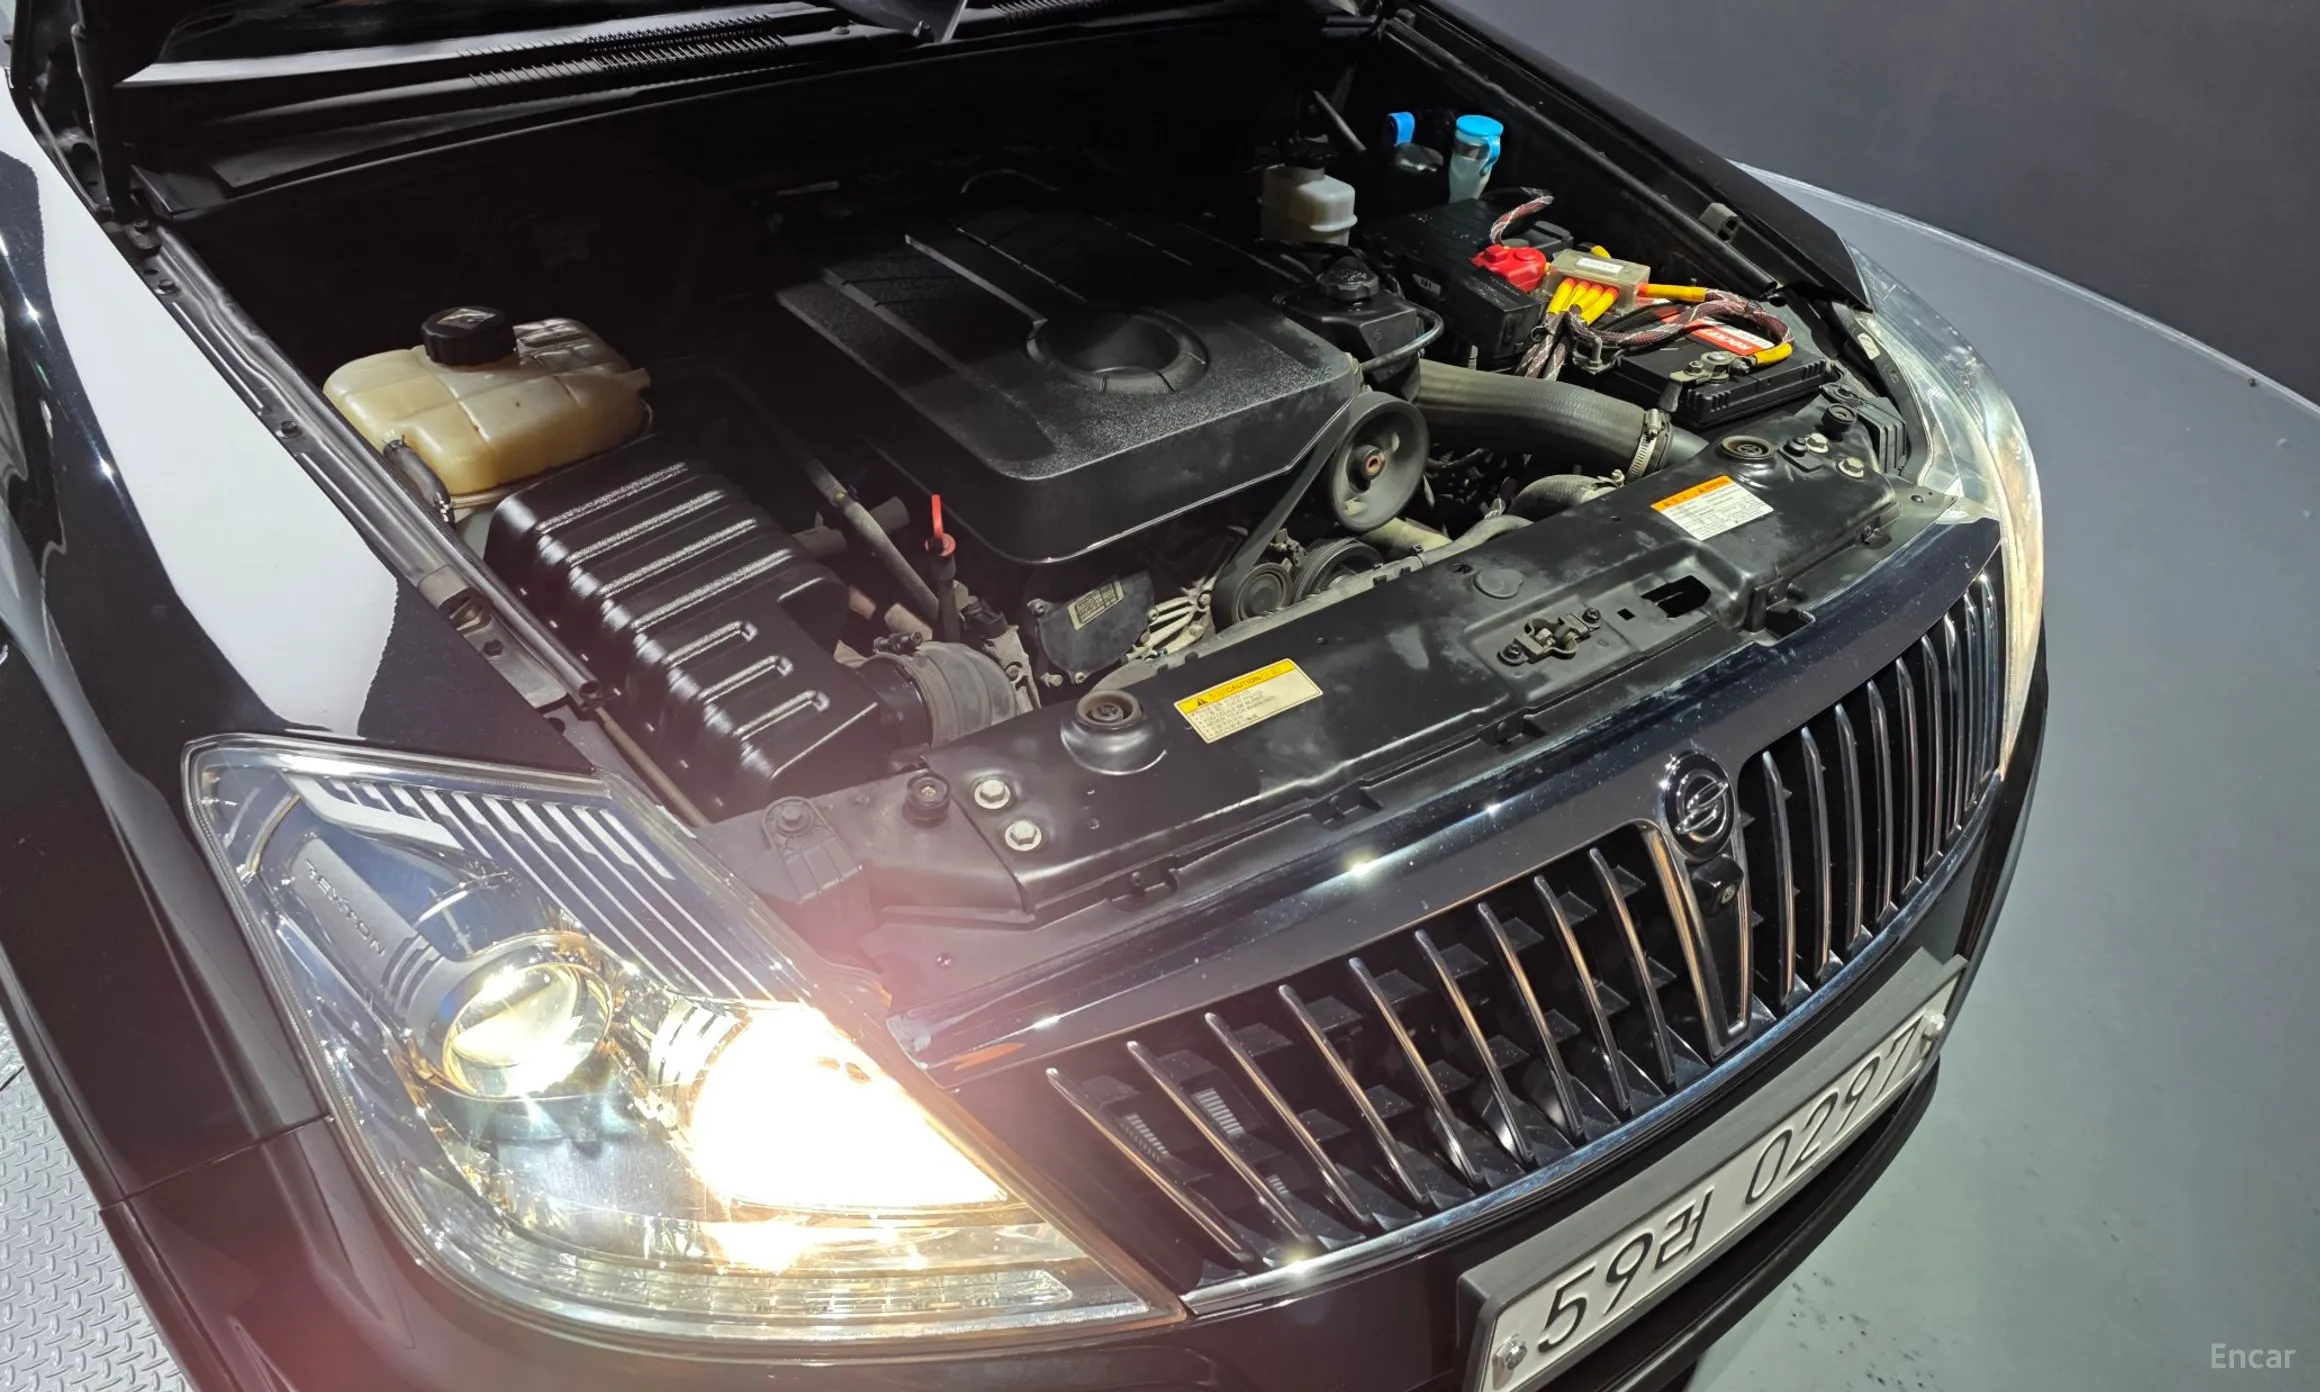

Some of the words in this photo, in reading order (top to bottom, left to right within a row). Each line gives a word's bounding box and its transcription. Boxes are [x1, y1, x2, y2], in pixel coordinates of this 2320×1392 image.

[305, 858, 387, 957] REXTON
[1537, 1185, 1714, 1353] 59러
[1743, 1010, 1925, 1206] 0297
